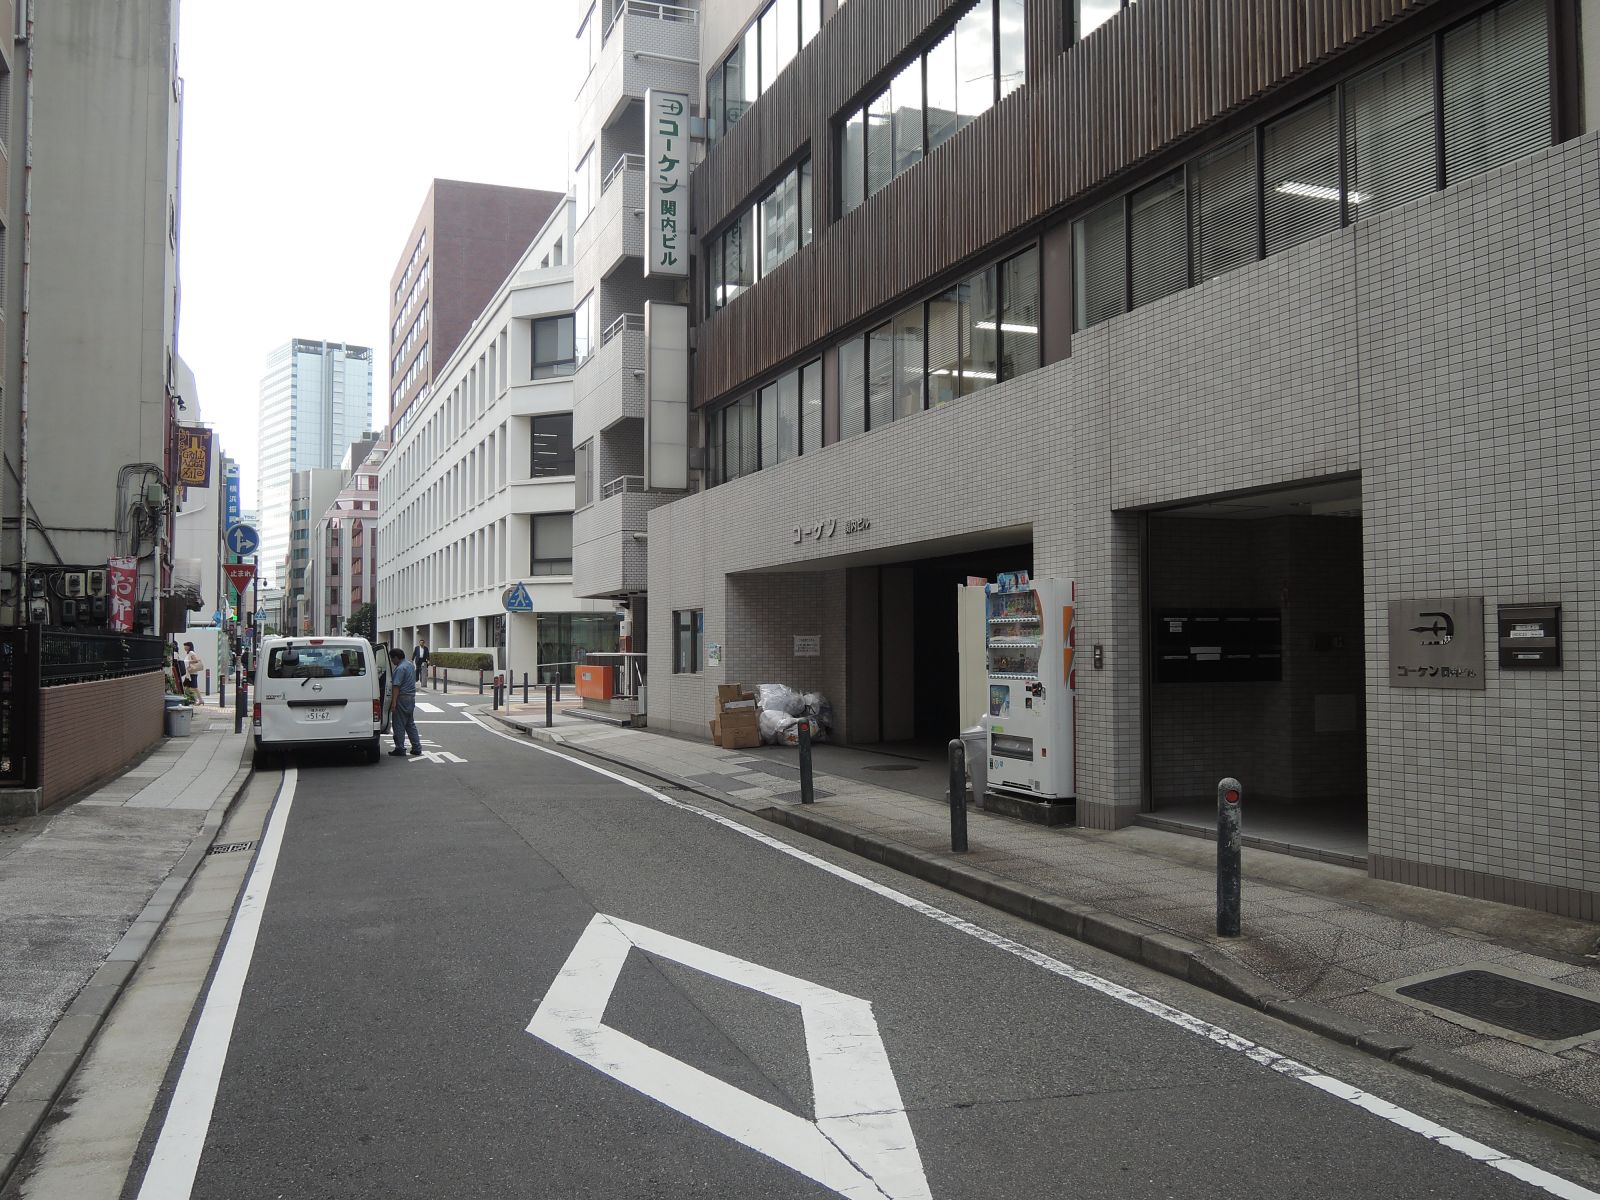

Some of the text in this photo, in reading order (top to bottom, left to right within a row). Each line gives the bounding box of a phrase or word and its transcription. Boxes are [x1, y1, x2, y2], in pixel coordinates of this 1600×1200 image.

[657, 118, 680, 267] コーケン関内ビル
[230, 569, 251, 578] 止まれ
